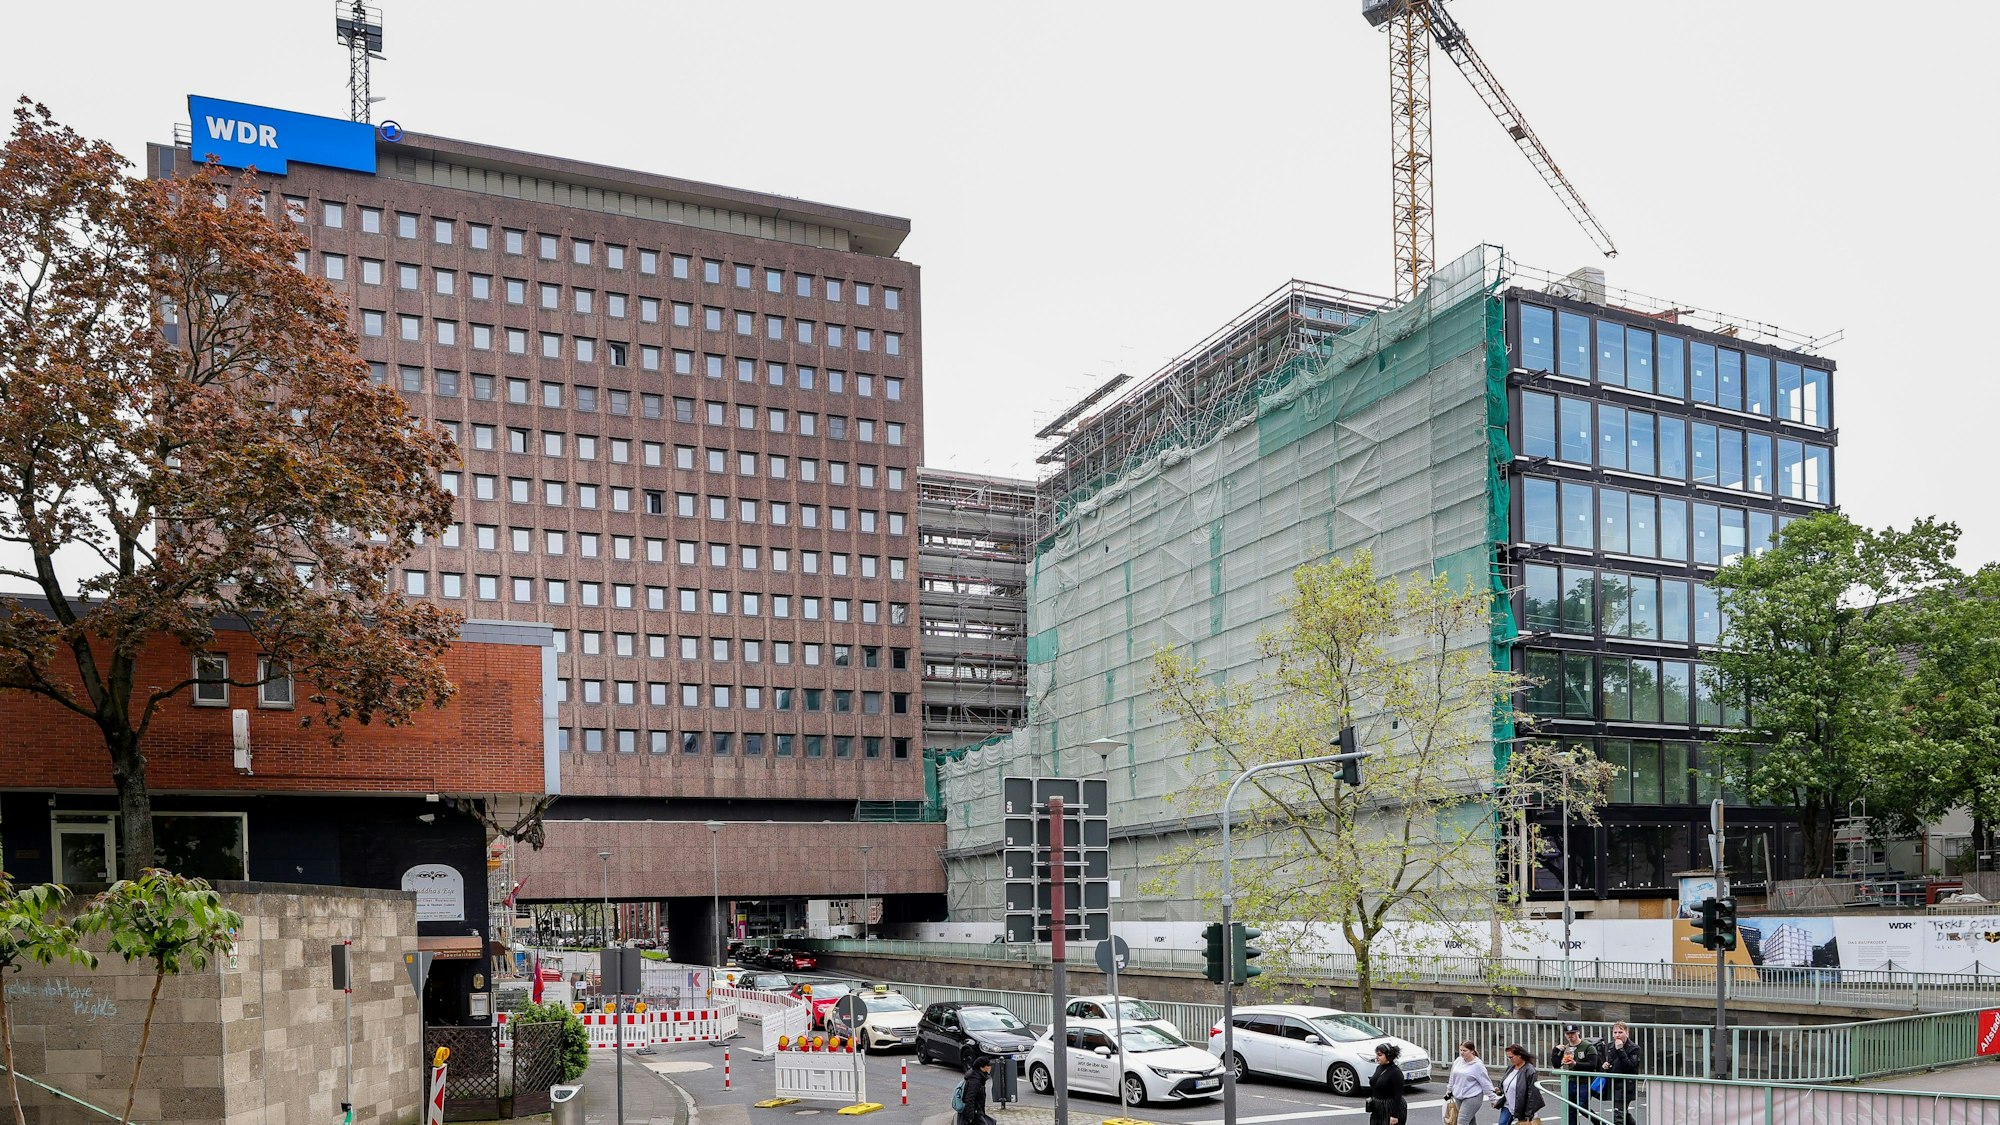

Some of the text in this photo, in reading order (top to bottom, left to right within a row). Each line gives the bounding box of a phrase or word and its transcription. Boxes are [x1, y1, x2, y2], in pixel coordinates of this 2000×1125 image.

[206, 115, 279, 149] WDR
[1889, 922, 1913, 930] WDR
[1444, 940, 1463, 949] WDR
[1559, 940, 1582, 949] WDR
